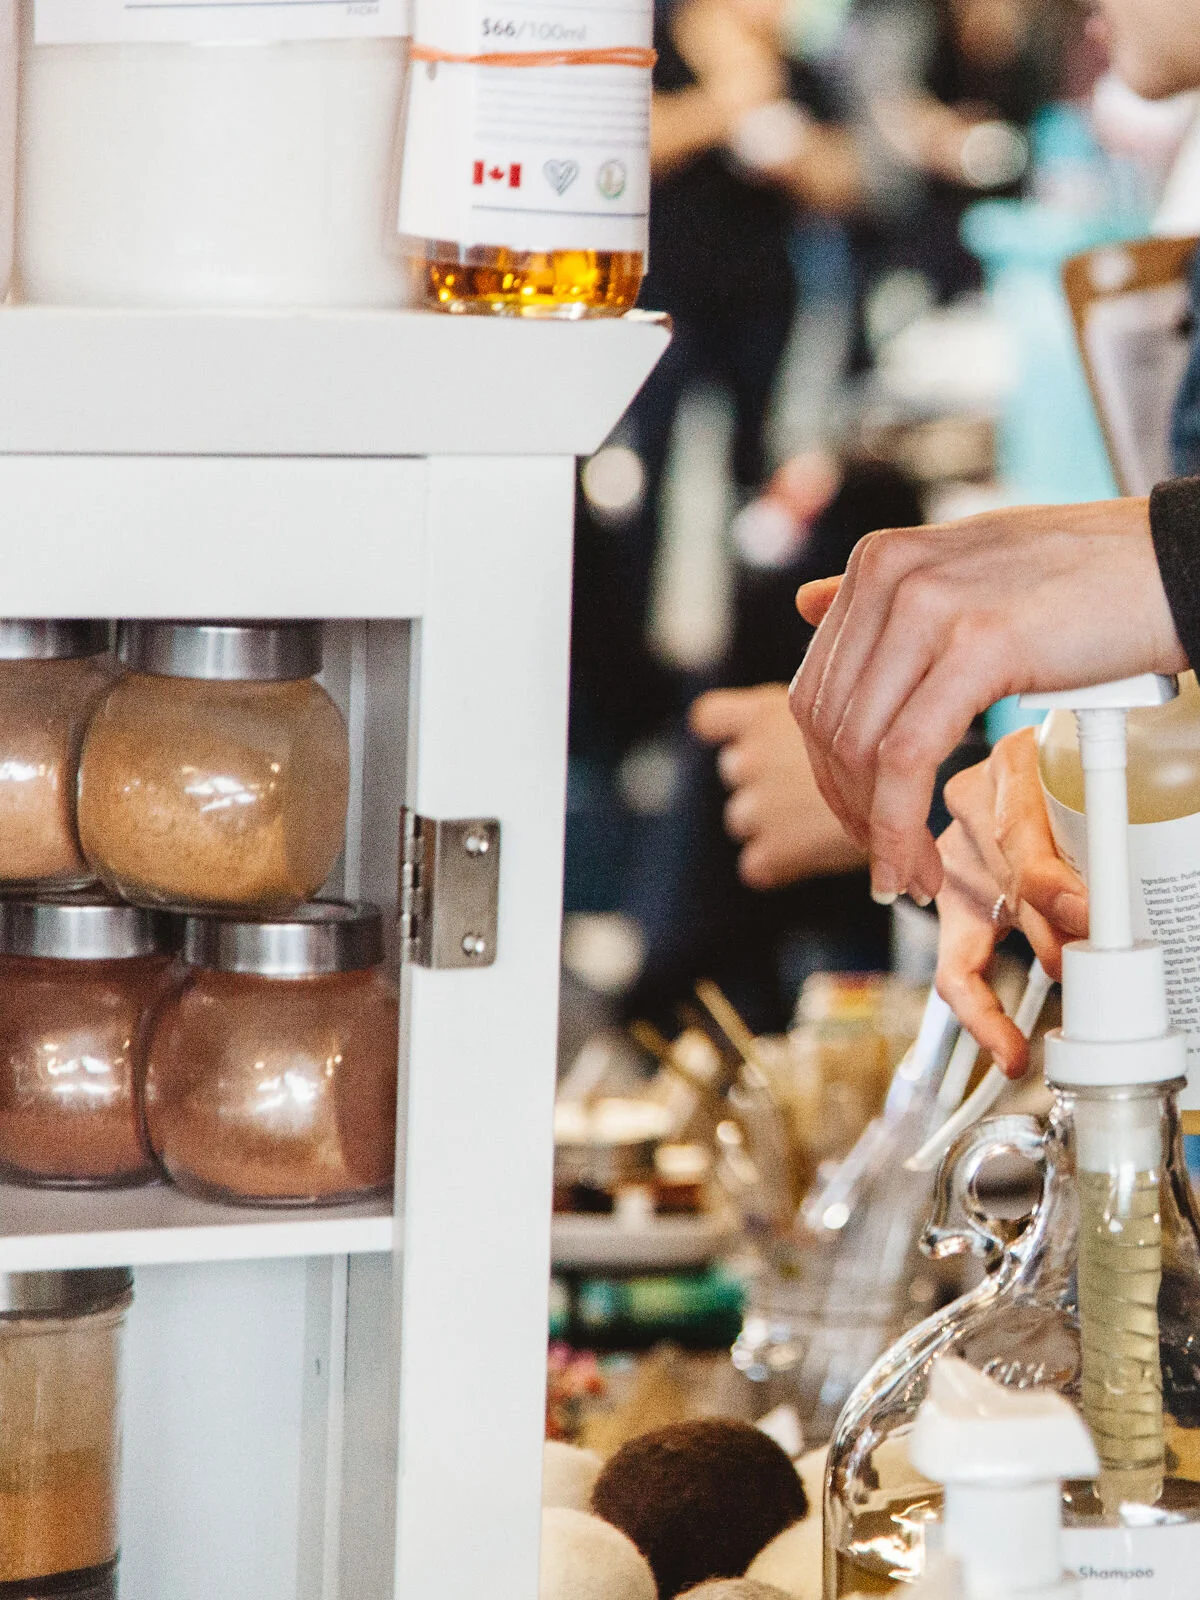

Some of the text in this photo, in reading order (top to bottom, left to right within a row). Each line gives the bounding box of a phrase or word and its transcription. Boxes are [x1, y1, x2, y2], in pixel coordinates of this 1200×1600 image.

[1173, 883, 1197, 892] Organic
[1147, 908, 1172, 916] Organic
[1149, 918, 1173, 926] Organic
[1078, 1566, 1155, 1581] Shampoo
